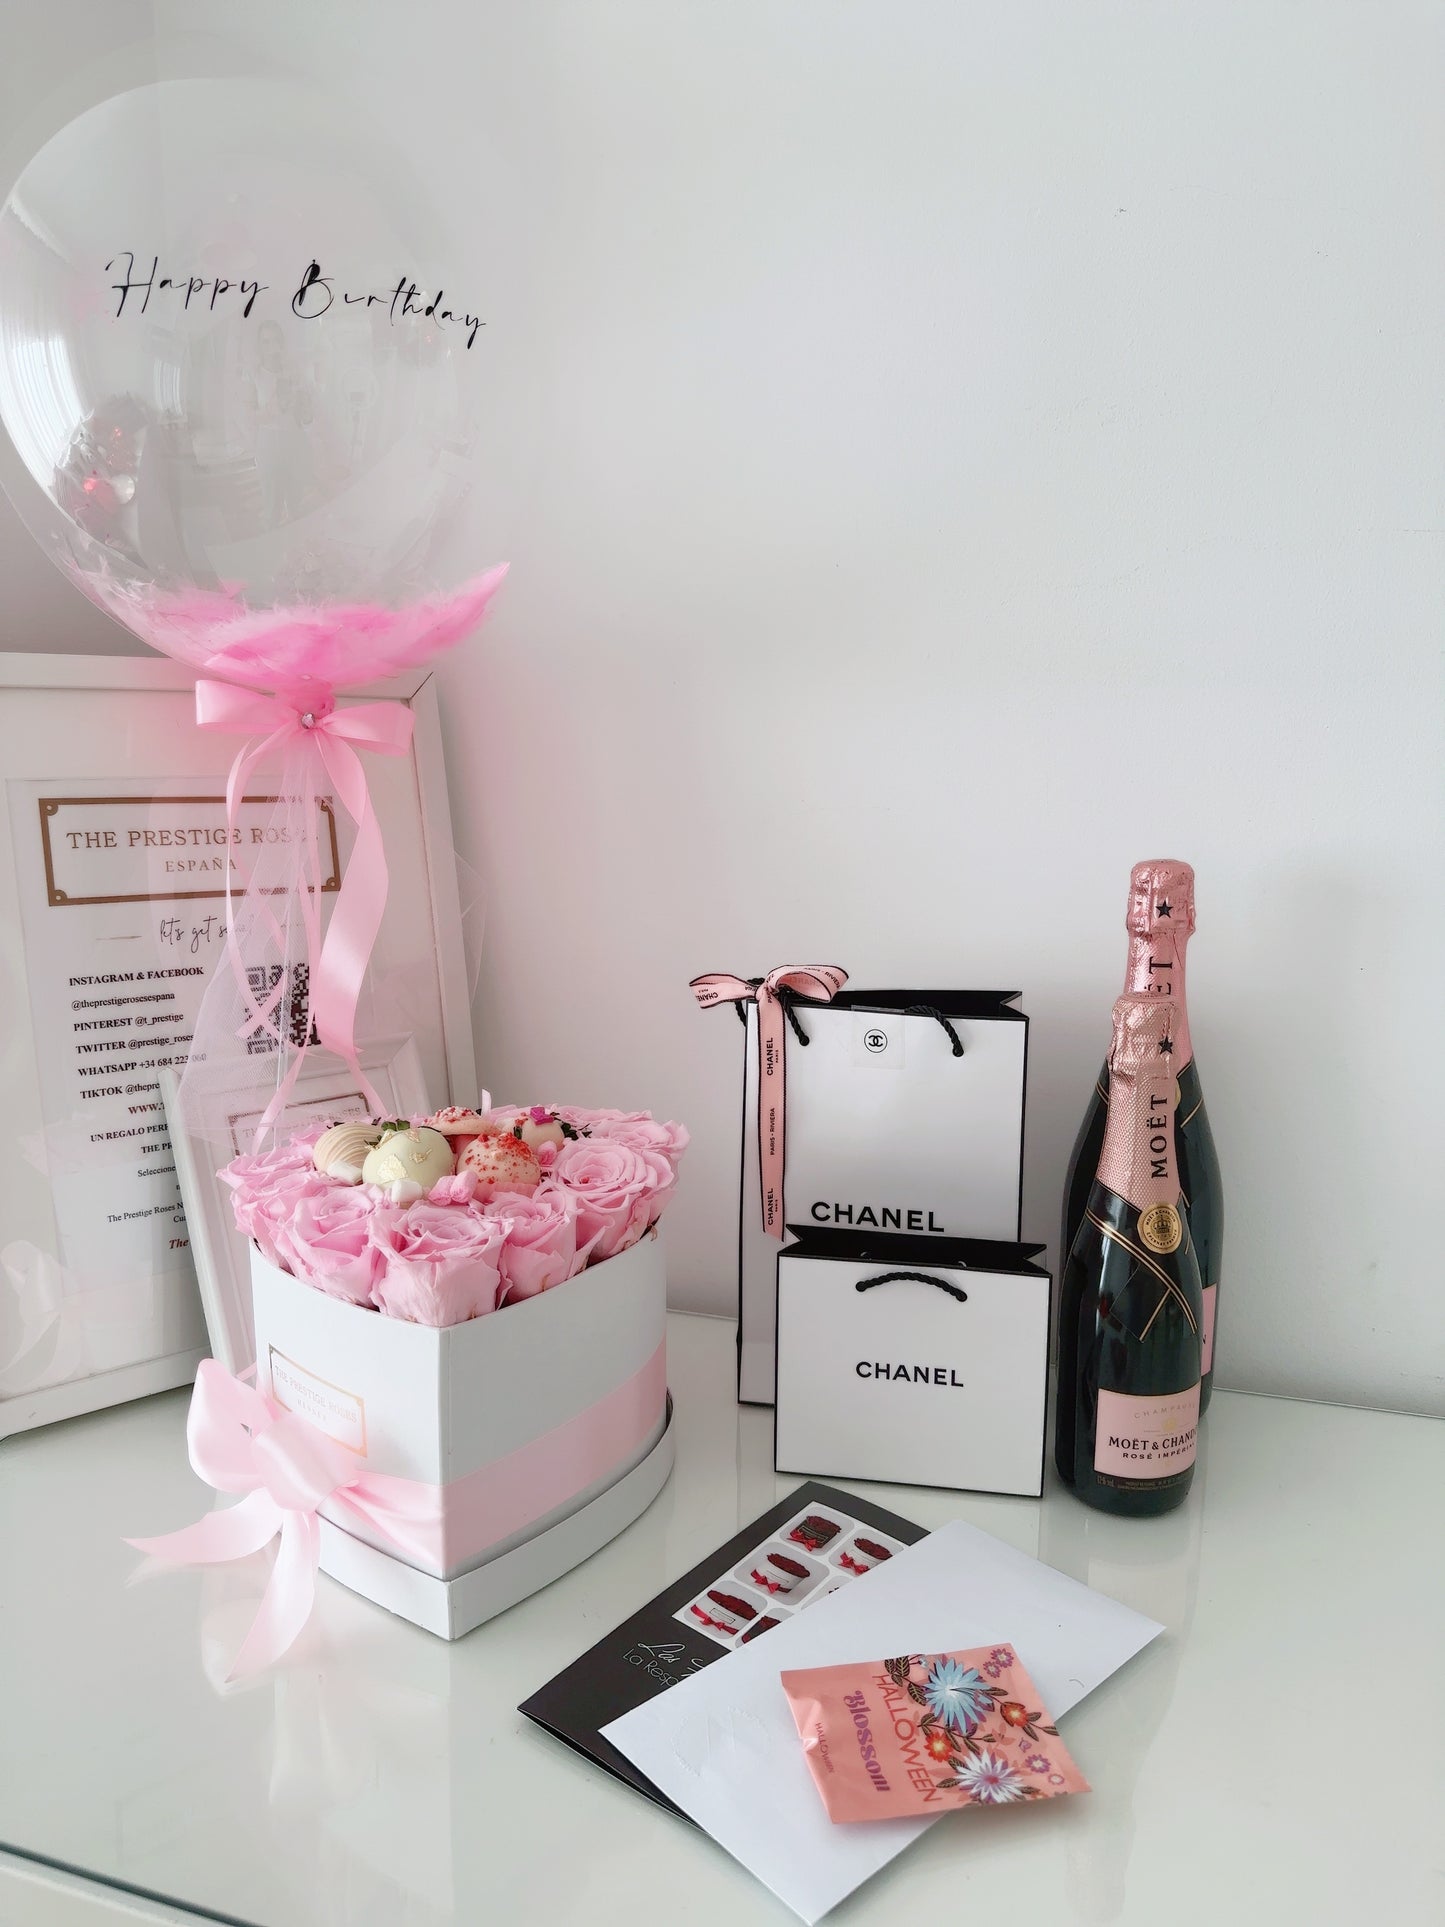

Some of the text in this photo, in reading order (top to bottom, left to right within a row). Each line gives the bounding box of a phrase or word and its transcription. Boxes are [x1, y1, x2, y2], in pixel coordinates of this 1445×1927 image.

[105, 252, 487, 350] Happy Birthday
[66, 831, 117, 849] THE
[128, 828, 242, 847] PRESTIGE
[165, 857, 237, 873] ESPAÑA
[190, 915, 218, 953] get
[69, 967, 204, 986] INSTAGRAM & FACEBOOK
[72, 993, 175, 1011] @theprestigerosesespana
[74, 1013, 184, 1031] PINTEREST @t_prestige
[76, 1034, 194, 1054] TWITTER @prestige_roses
[78, 1062, 137, 1077] WHATSAPP
[139, 1059, 155, 1069] +34
[158, 1057, 172, 1067] 684
[80, 1086, 122, 1099] TIKTOK
[91, 1134, 104, 1142] UN
[106, 1127, 145, 1140] REGALO
[1146, 1094, 1169, 1179] MOËT
[141, 1145, 160, 1153] THE
[108, 1214, 122, 1223] The
[124, 1209, 153, 1220] Prestige
[154, 1204, 175, 1213] Roses
[811, 1201, 945, 1233] CHANEL
[169, 1238, 189, 1249] The
[856, 1361, 964, 1388] CHANEL
[1108, 1435, 1149, 1451] MOËT
[1151, 1441, 1159, 1450] &
[1122, 1452, 1153, 1460] ROSÉ
[623, 1648, 643, 1666] La
[843, 1690, 891, 1792] Blossom
[872, 1674, 943, 1802] HALLOWEEN
